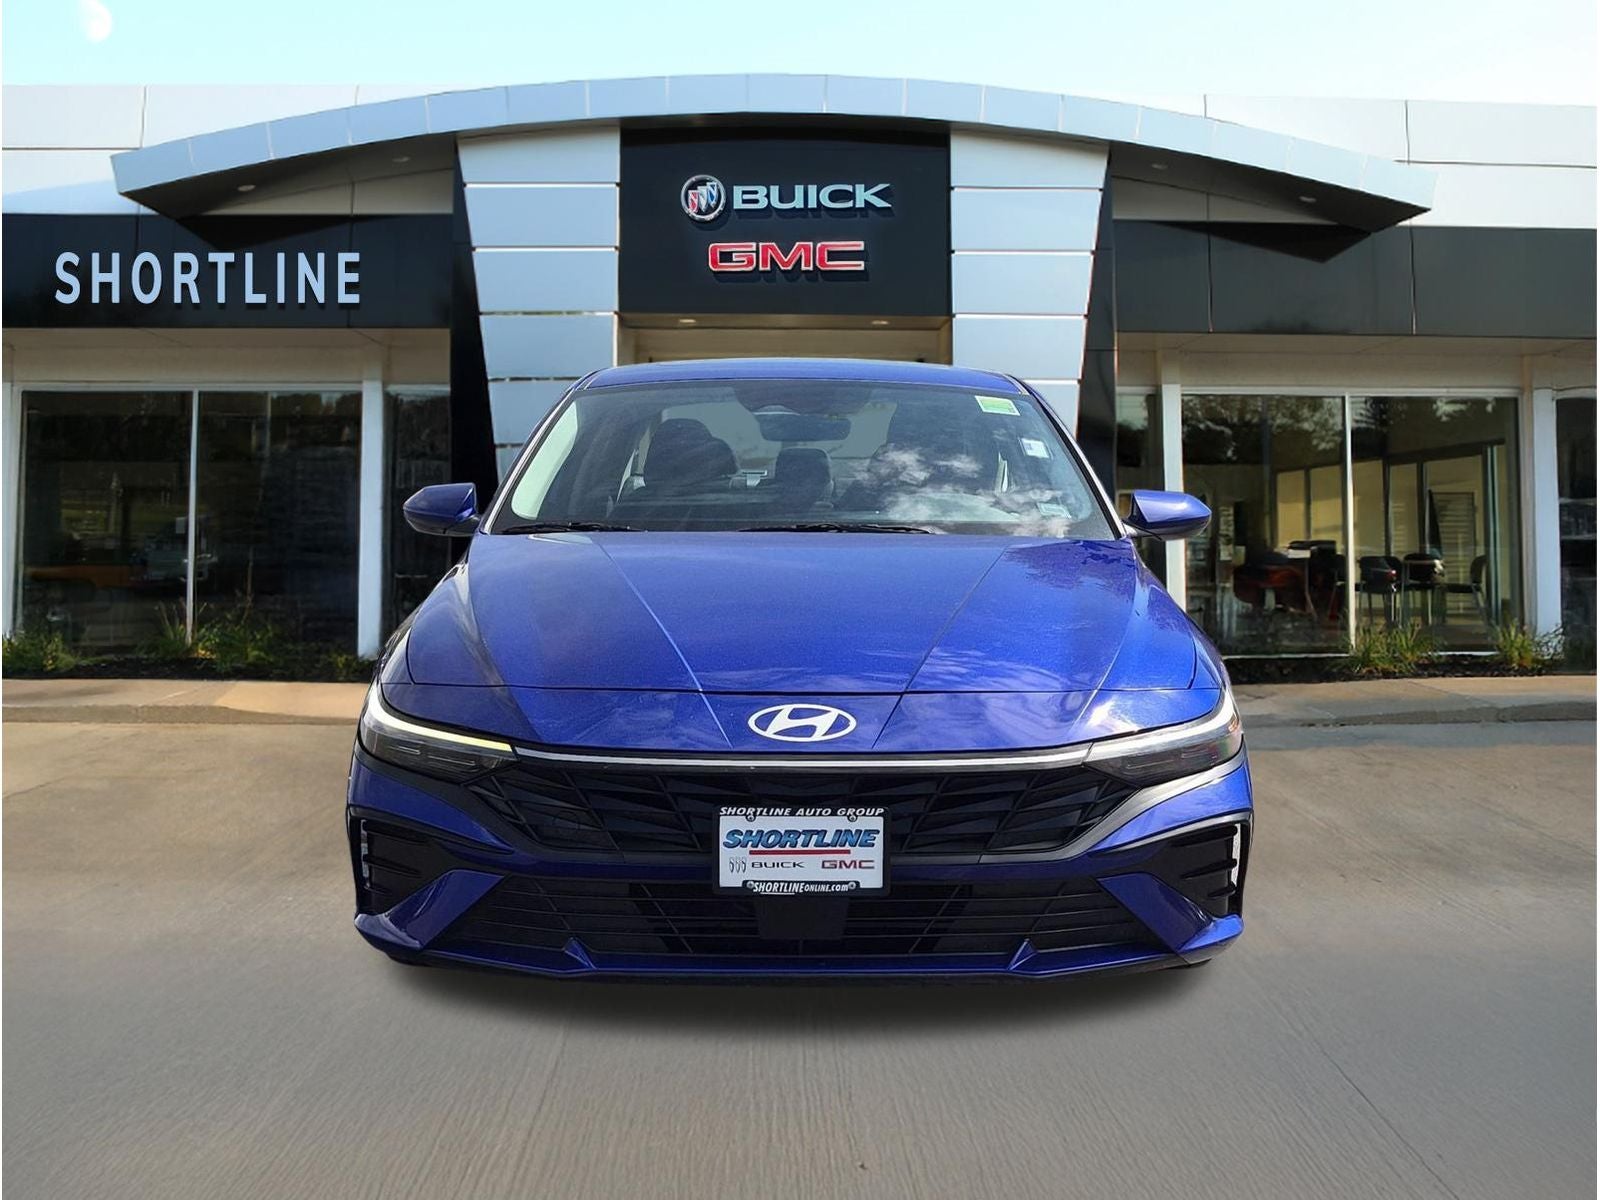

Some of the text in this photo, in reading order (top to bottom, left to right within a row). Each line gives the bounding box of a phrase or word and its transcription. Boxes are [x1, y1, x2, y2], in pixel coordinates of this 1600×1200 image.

[732, 183, 893, 210] BUICK
[708, 240, 865, 272] GMC
[54, 251, 361, 305] SHORTLINE
[719, 806, 885, 816] SHORTLINE AUTO GROUP
[722, 829, 880, 849] SHORTLINE
[751, 861, 805, 869] BUICK
[821, 859, 875, 870] GMC
